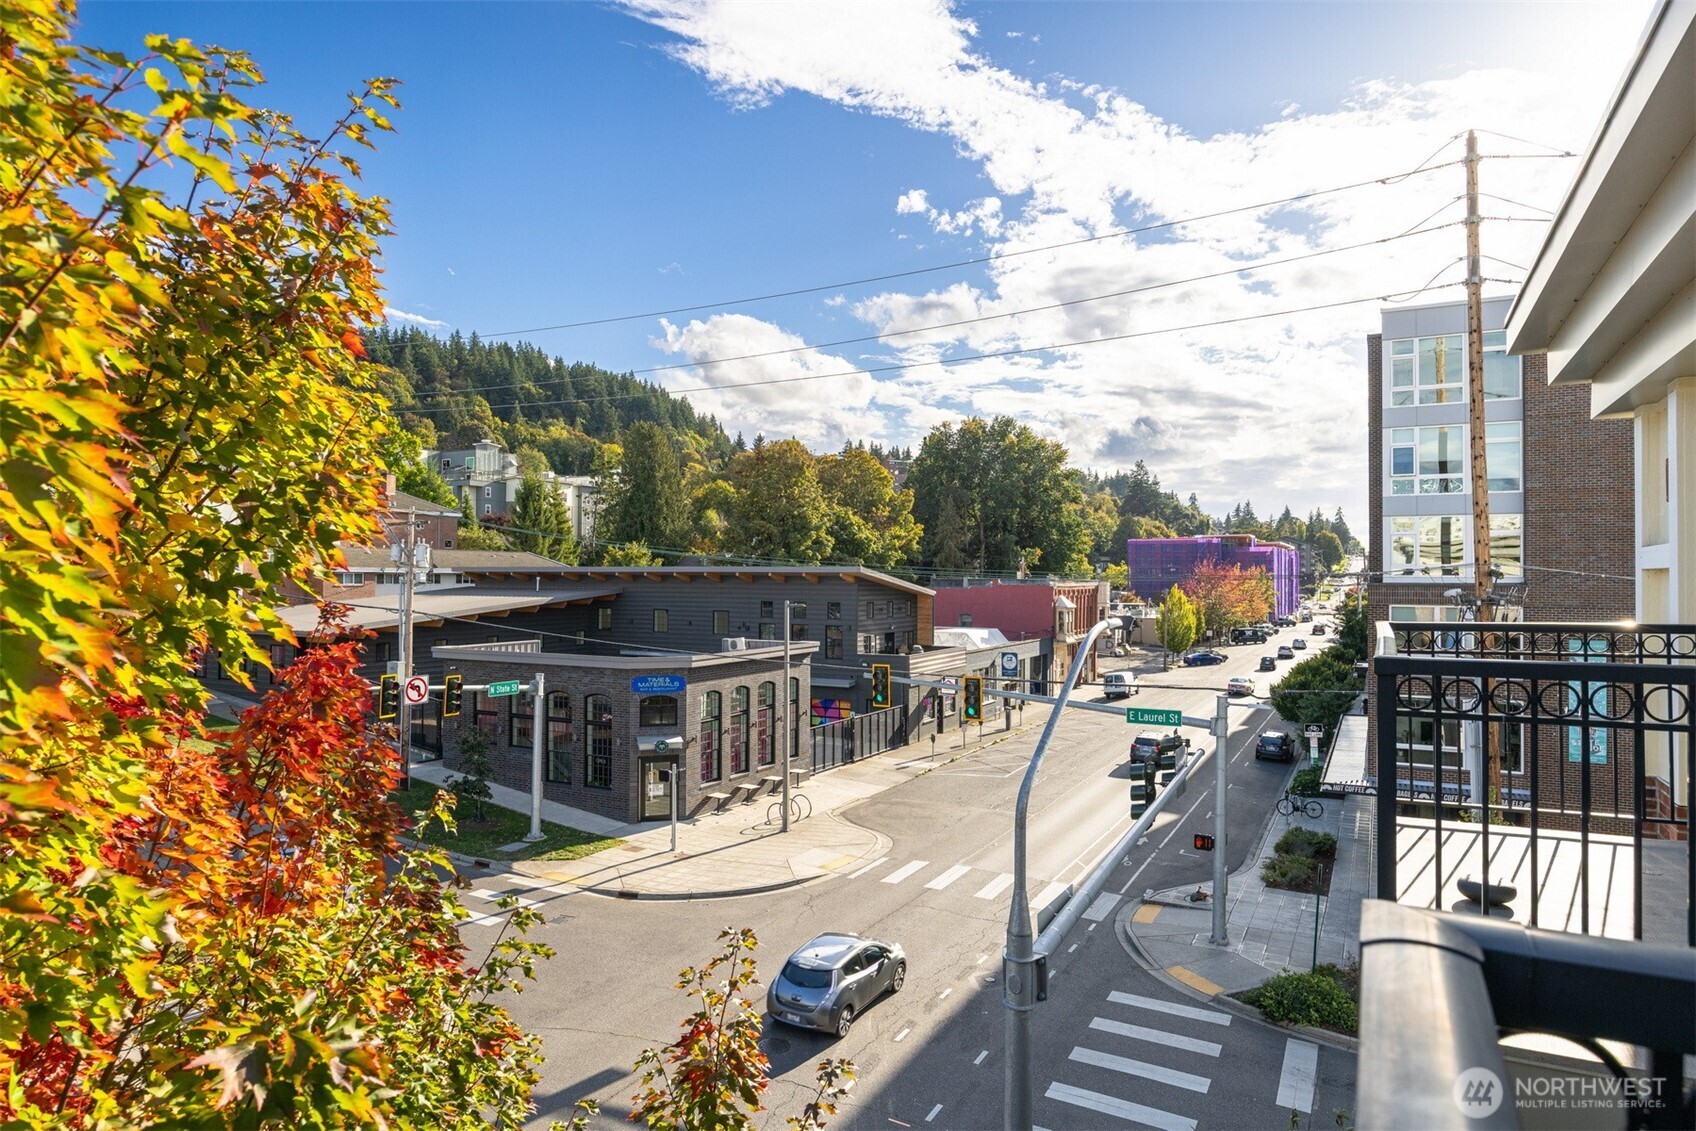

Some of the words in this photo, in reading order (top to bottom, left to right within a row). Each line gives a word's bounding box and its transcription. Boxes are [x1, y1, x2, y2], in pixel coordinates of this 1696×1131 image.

[490, 686, 495, 694] N
[496, 684, 511, 693] State
[511, 683, 518, 691] St
[1129, 711, 1135, 720] E
[1138, 712, 1166, 723] Laurel
[1169, 713, 1179, 723] St
[1344, 785, 1366, 794] COFFEE
[1396, 789, 1418, 799] BAGES
[1443, 794, 1466, 803] COFFE
